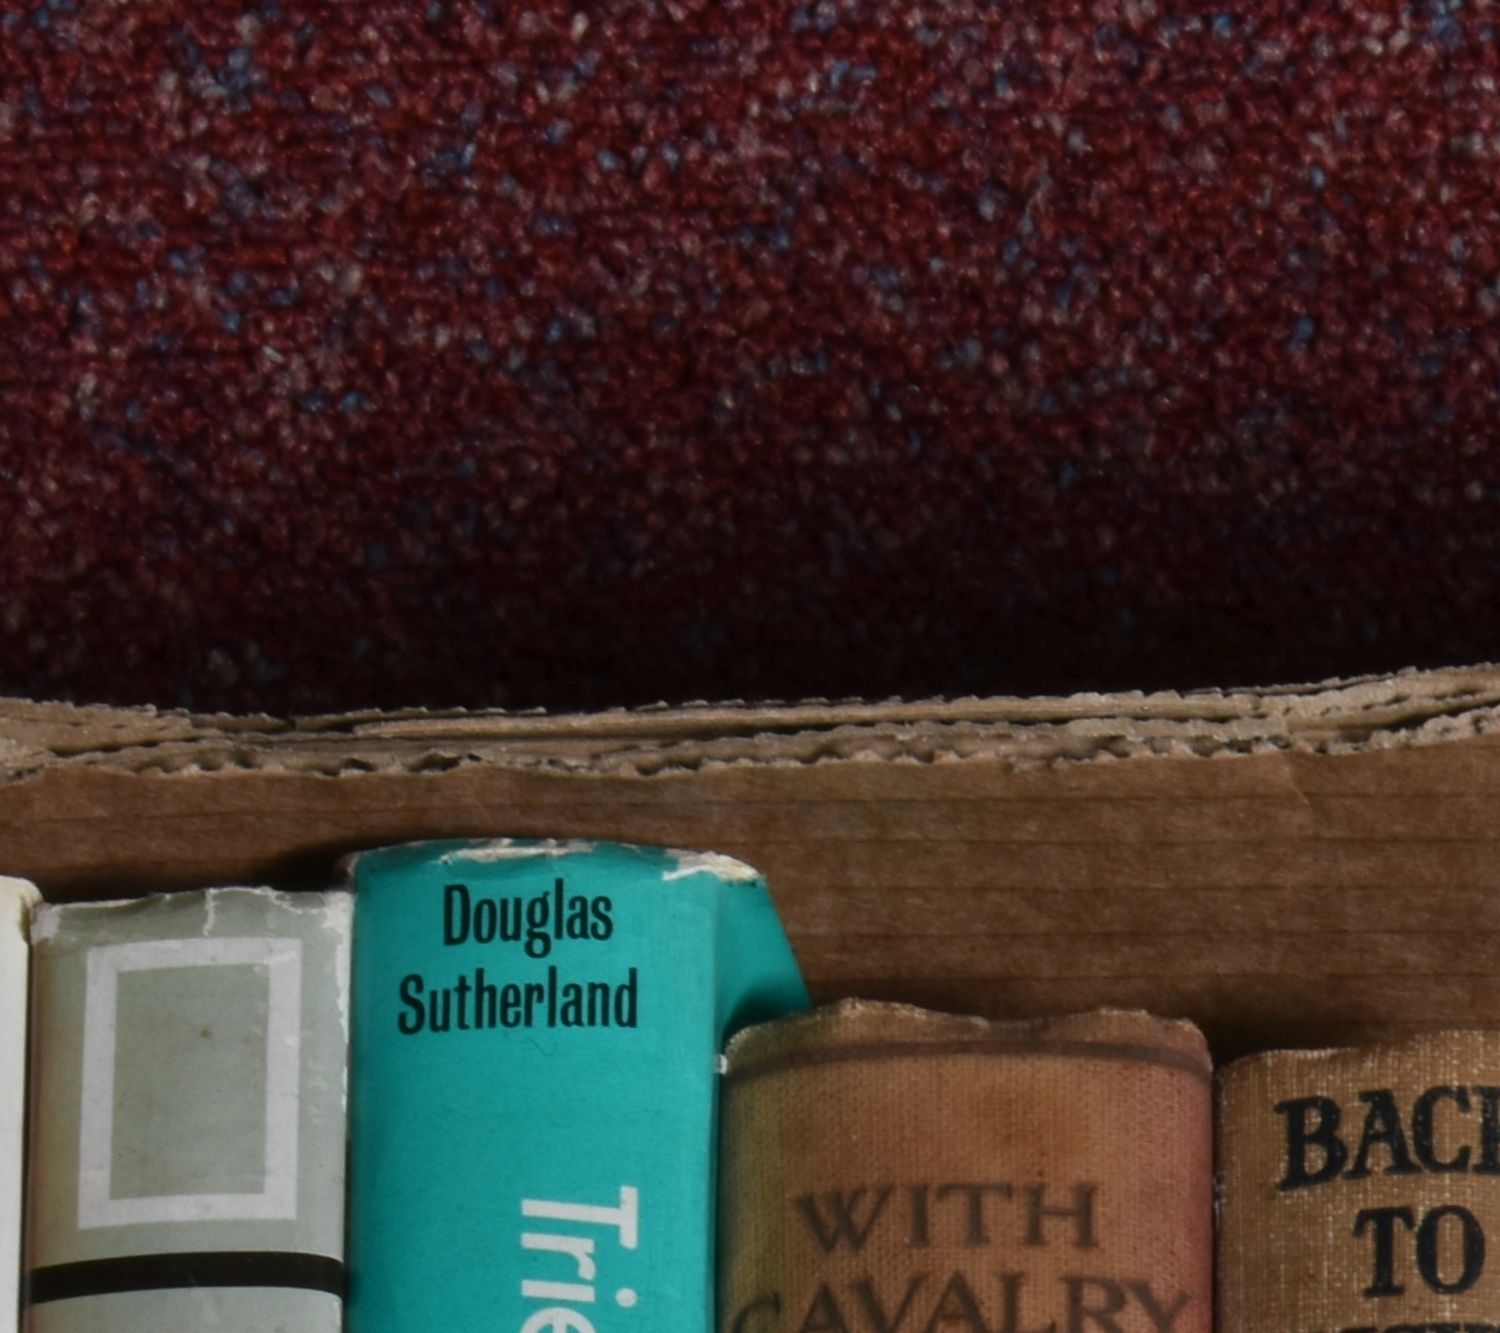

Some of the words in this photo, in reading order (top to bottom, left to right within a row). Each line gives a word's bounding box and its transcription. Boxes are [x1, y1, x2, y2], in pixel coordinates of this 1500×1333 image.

[441, 878, 615, 960] Douglas
[398, 966, 640, 1036] Sutherland
[793, 1179, 1099, 1256] WITH
[1352, 1204, 1487, 1299] TO
